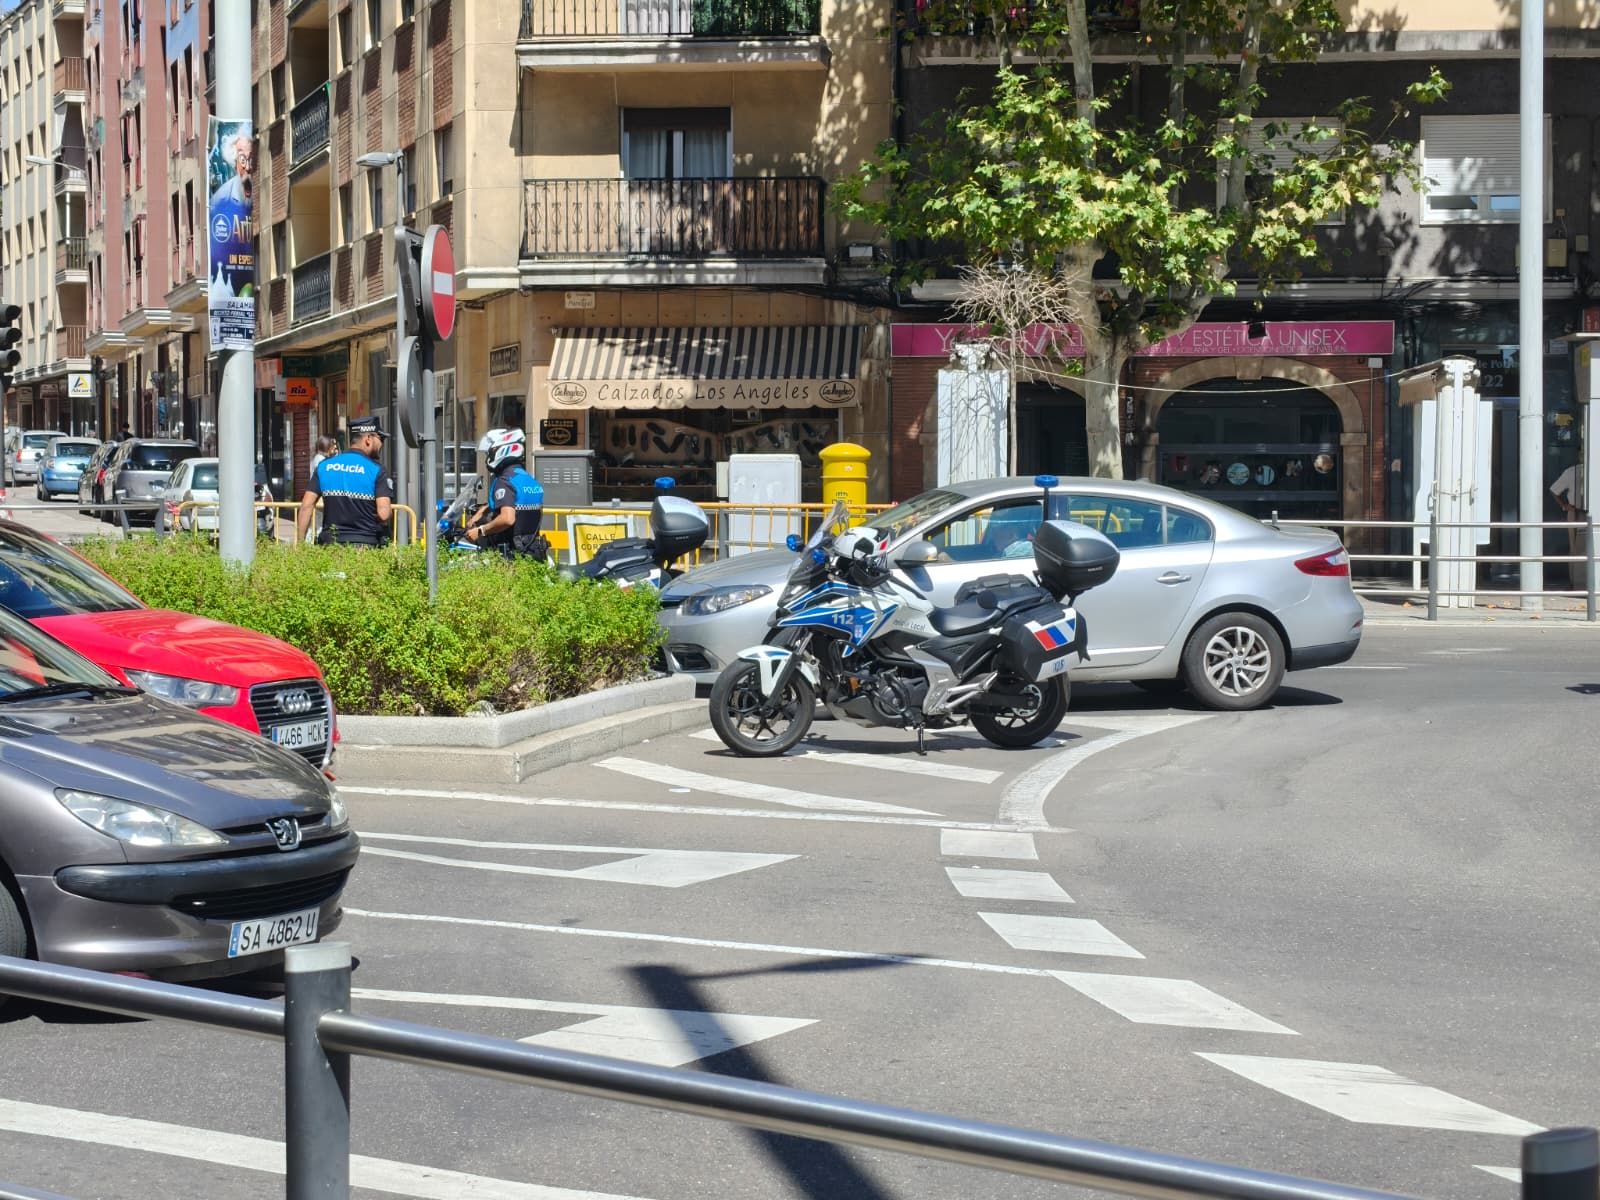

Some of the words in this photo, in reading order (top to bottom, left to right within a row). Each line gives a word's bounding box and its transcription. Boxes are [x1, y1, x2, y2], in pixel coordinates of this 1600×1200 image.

[1193, 326, 1273, 346] ESTÉTICA
[1279, 329, 1347, 346] UNISEX
[291, 385, 306, 394] Ria
[598, 382, 685, 400] Calzados
[695, 383, 725, 400] Los
[733, 381, 809, 405] Angeles
[326, 462, 365, 474] POLICÍA
[581, 543, 602, 551] COR
[831, 613, 854, 625] 112
[279, 726, 303, 746] 4466
[240, 924, 261, 951] SA
[267, 915, 302, 946] 4862
[306, 911, 316, 937] U
